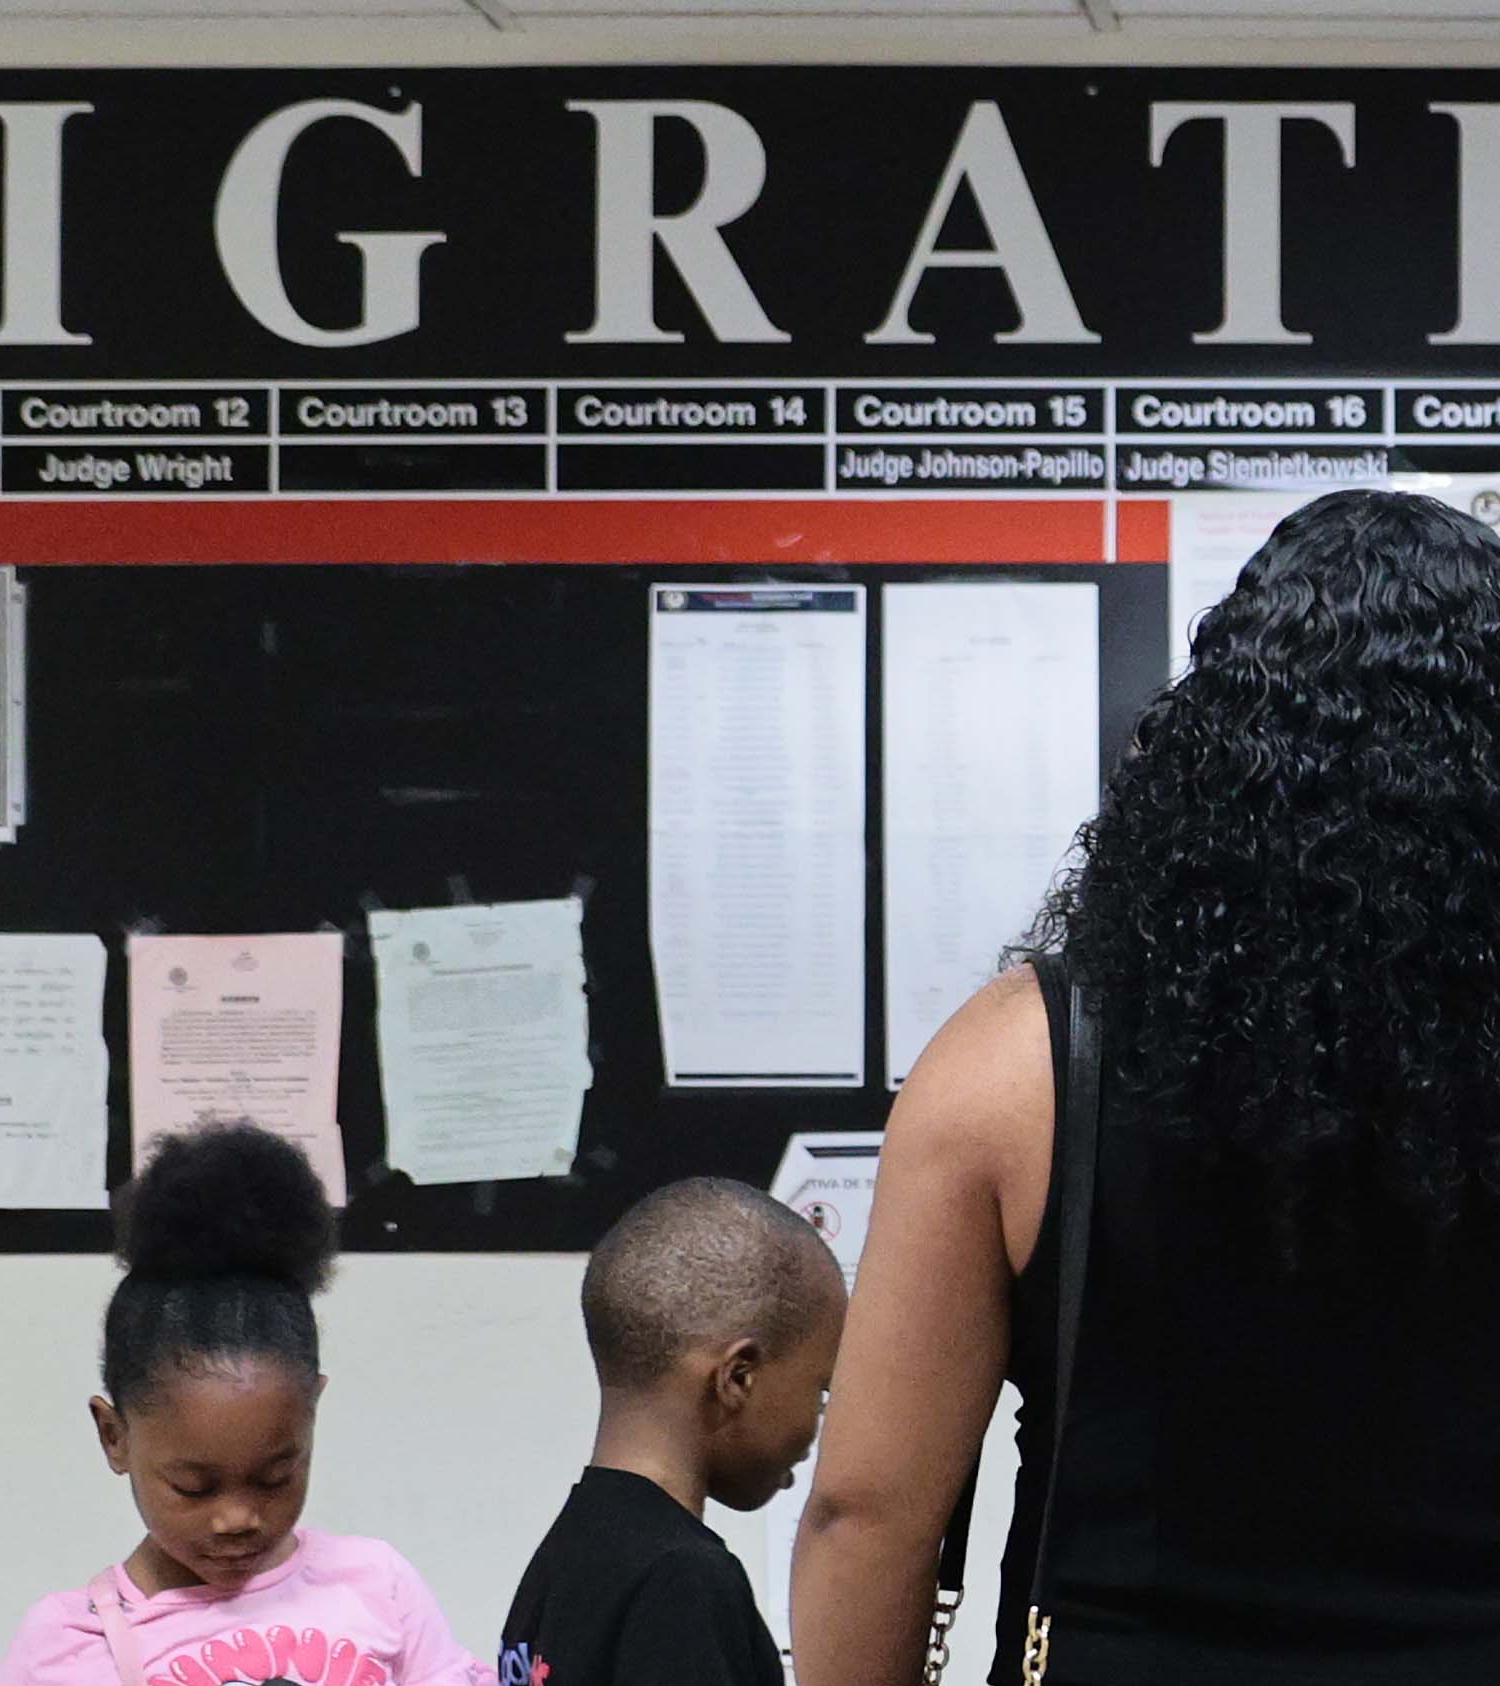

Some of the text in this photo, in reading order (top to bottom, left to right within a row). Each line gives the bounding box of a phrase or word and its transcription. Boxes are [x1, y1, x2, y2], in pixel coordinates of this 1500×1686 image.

[20, 398, 249, 427] Courtroom 12
[298, 397, 528, 427] Courtroom 13
[575, 396, 805, 426] Courtroom 14
[854, 396, 1086, 426] Courtroom 15
[1132, 395, 1366, 427] Courtroom 16
[39, 455, 233, 488] Judge Wright
[840, 449, 1104, 484] Judge Johnson-Papillo
[1125, 449, 1388, 487] Judge Siemietkowski
